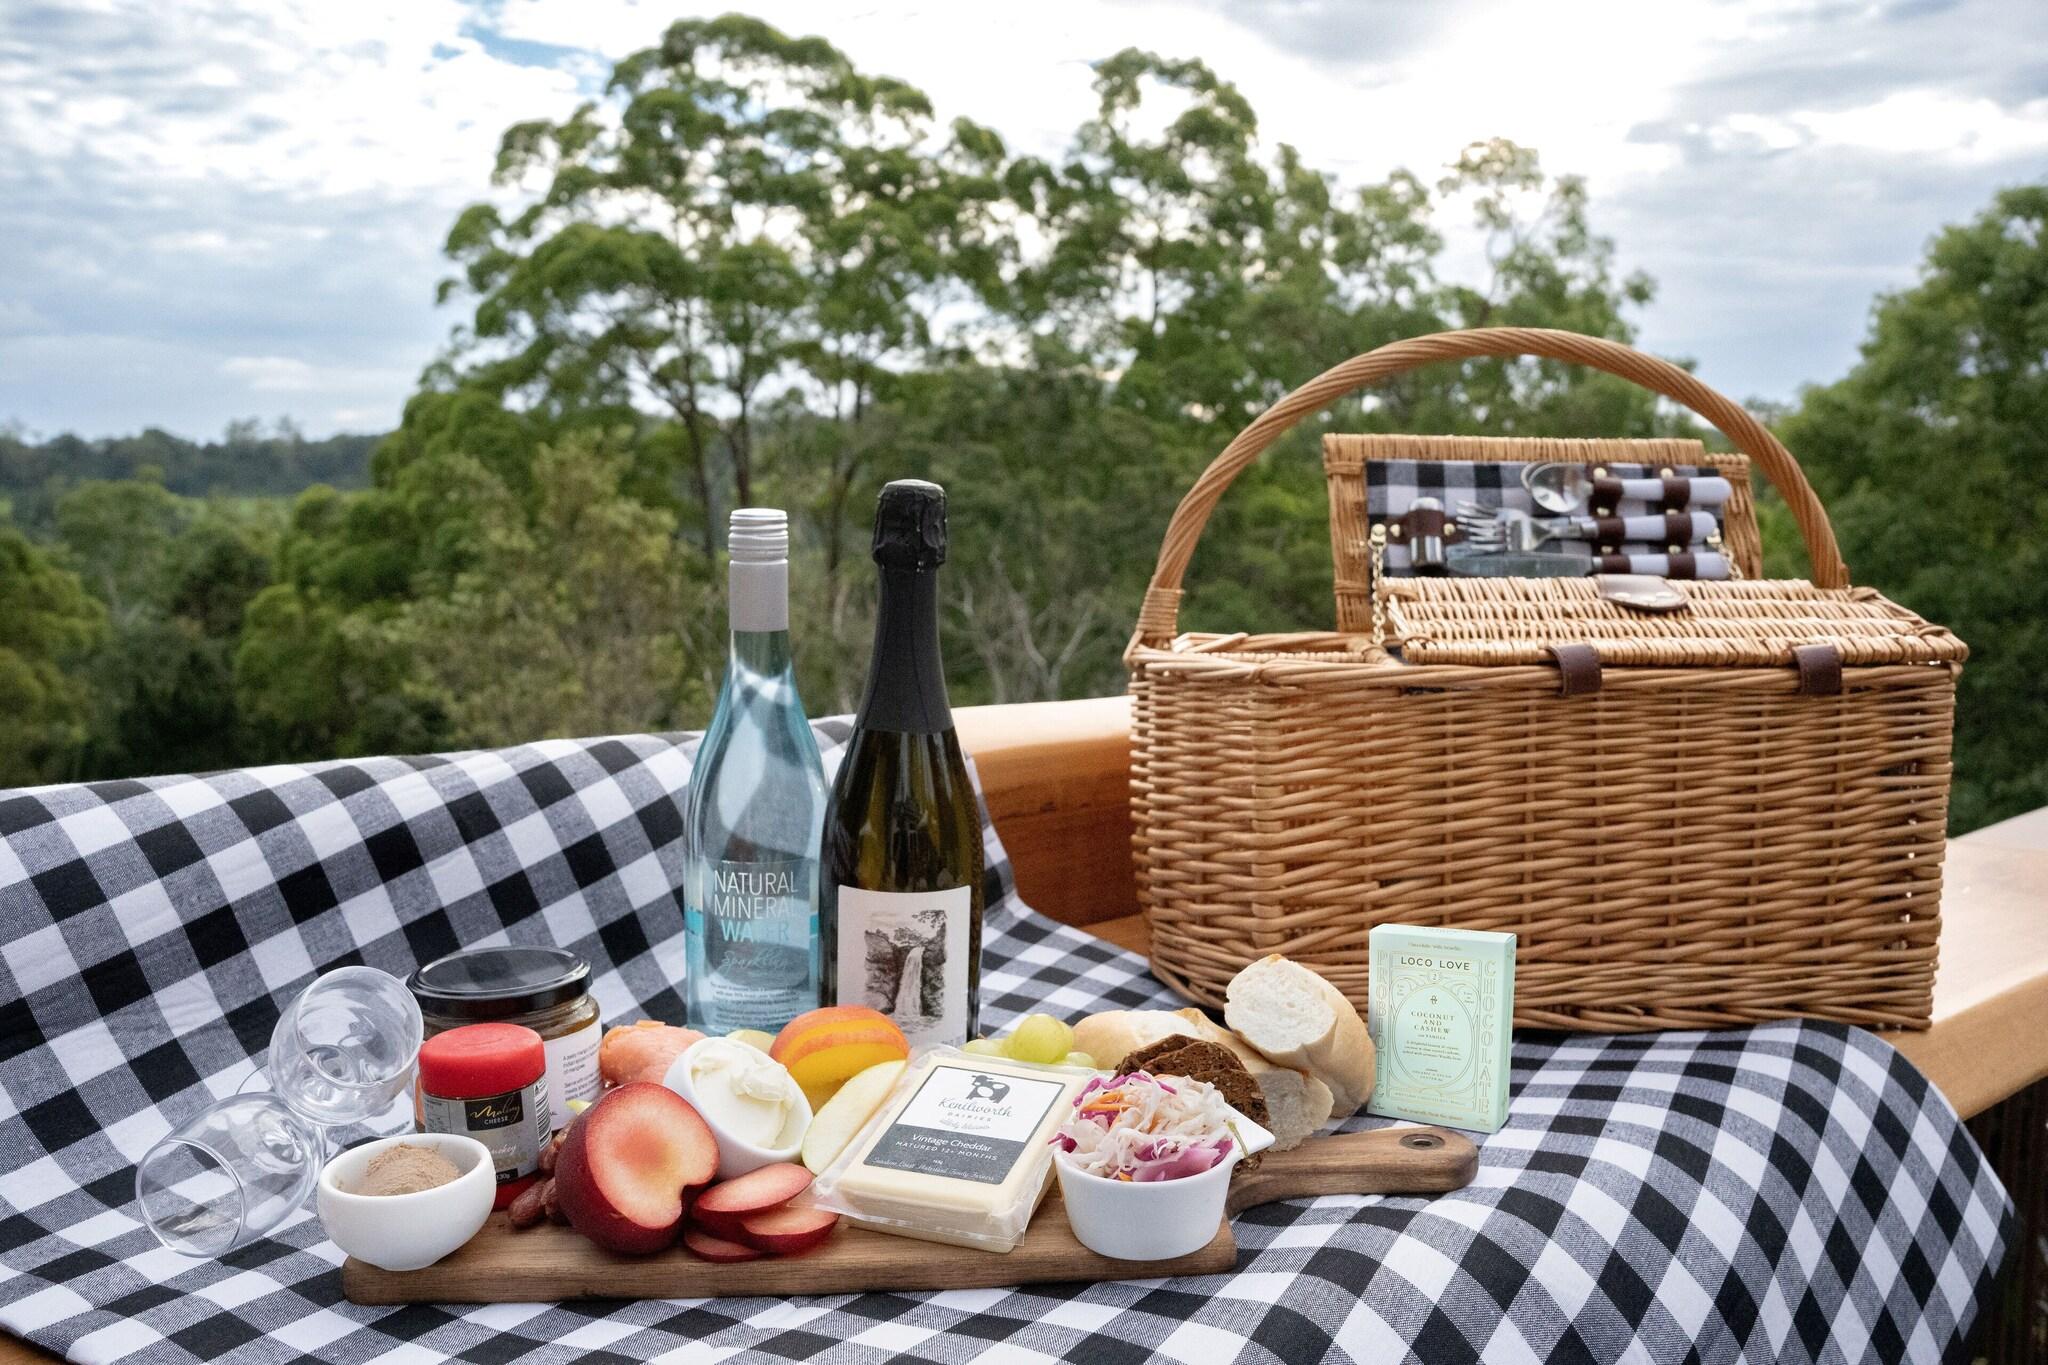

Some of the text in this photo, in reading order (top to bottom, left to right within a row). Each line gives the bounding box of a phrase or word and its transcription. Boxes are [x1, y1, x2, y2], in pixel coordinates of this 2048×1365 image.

[714, 869, 798, 895] NATURAL
[714, 894, 798, 919] MINERAL
[721, 919, 789, 943] WAR
[1401, 956, 1471, 971] LOCO LOVE
[1411, 1011, 1455, 1021] COCONUT
[1423, 1018, 1442, 1027] AND
[1414, 1025, 1451, 1035] CASHEW
[938, 1097, 1013, 1117] Kenilworth
[484, 1115, 508, 1125] CHEESE
[895, 1141, 938, 1152] MATURED
[958, 1150, 998, 1161] MONTHS
[912, 1133, 993, 1152] Vintage Cheddar
